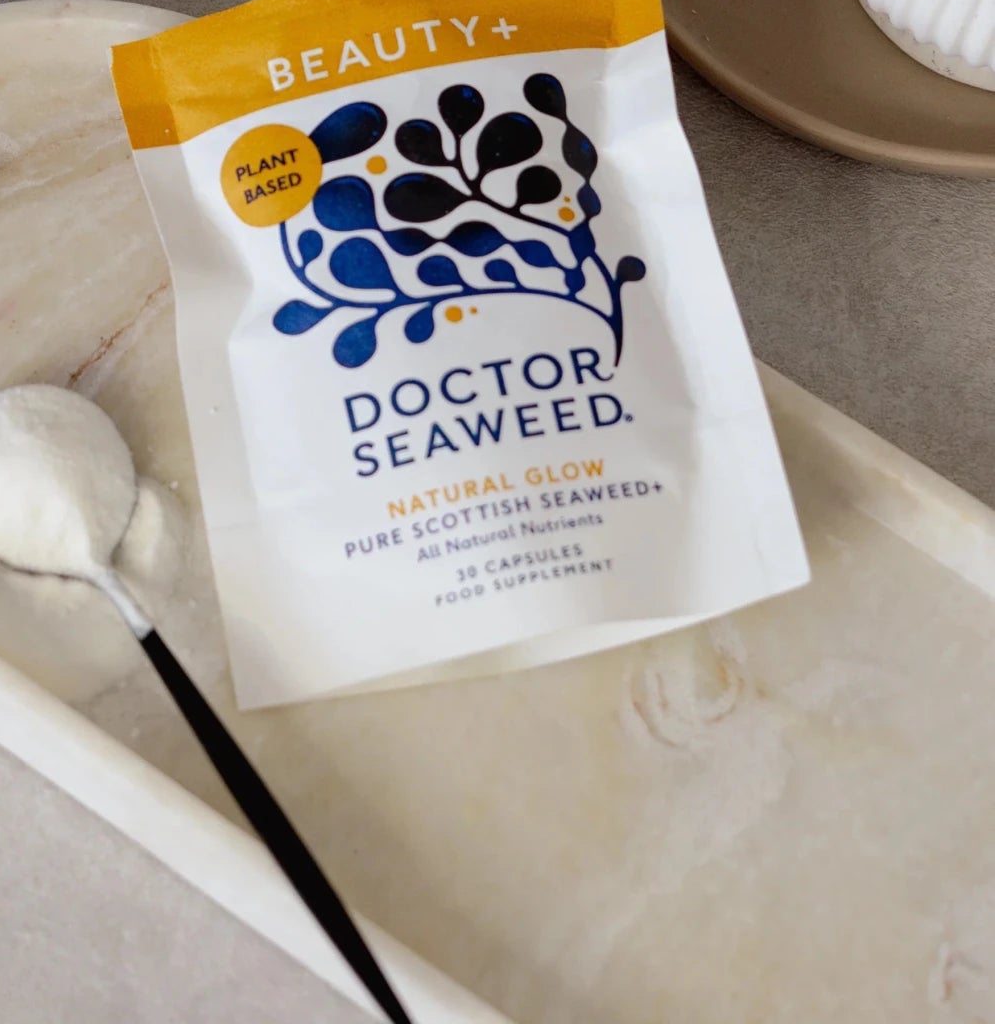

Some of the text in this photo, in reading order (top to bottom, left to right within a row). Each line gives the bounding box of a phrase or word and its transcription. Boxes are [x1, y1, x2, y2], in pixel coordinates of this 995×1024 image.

[267, 14, 520, 93] BEAUTY+
[235, 148, 299, 182] PLANT
[244, 171, 303, 205] BASED
[344, 347, 613, 434] DOCTOR
[387, 458, 606, 520] NATURAL GLOW
[344, 480, 664, 560] PURE SCOTTISH SEAWEED+
[417, 513, 604, 564] All Natural Nutrients
[434, 558, 614, 608] FOOD SUPPLEMENT
[455, 542, 584, 583] 30 CAPSULES
